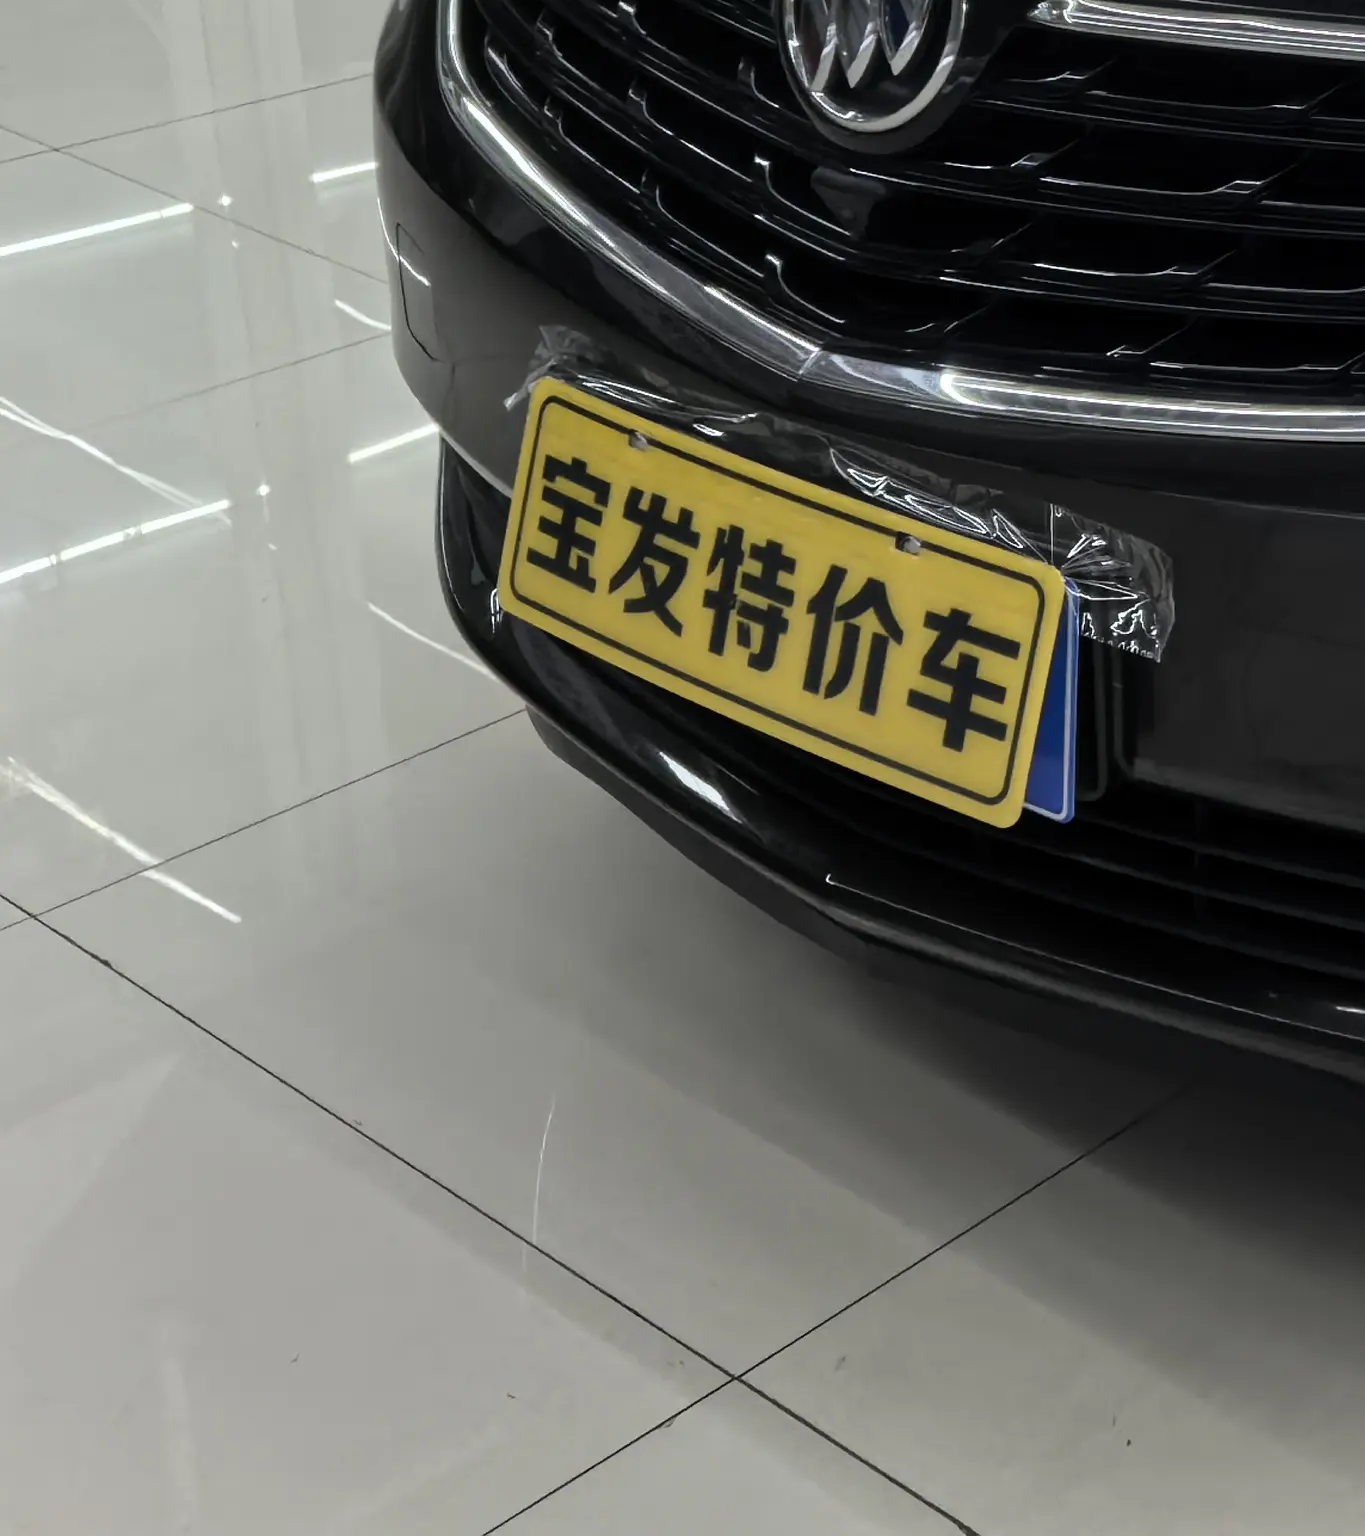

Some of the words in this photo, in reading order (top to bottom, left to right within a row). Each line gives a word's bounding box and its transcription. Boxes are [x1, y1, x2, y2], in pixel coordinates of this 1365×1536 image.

[527, 454, 1020, 752] 宝发特价车
